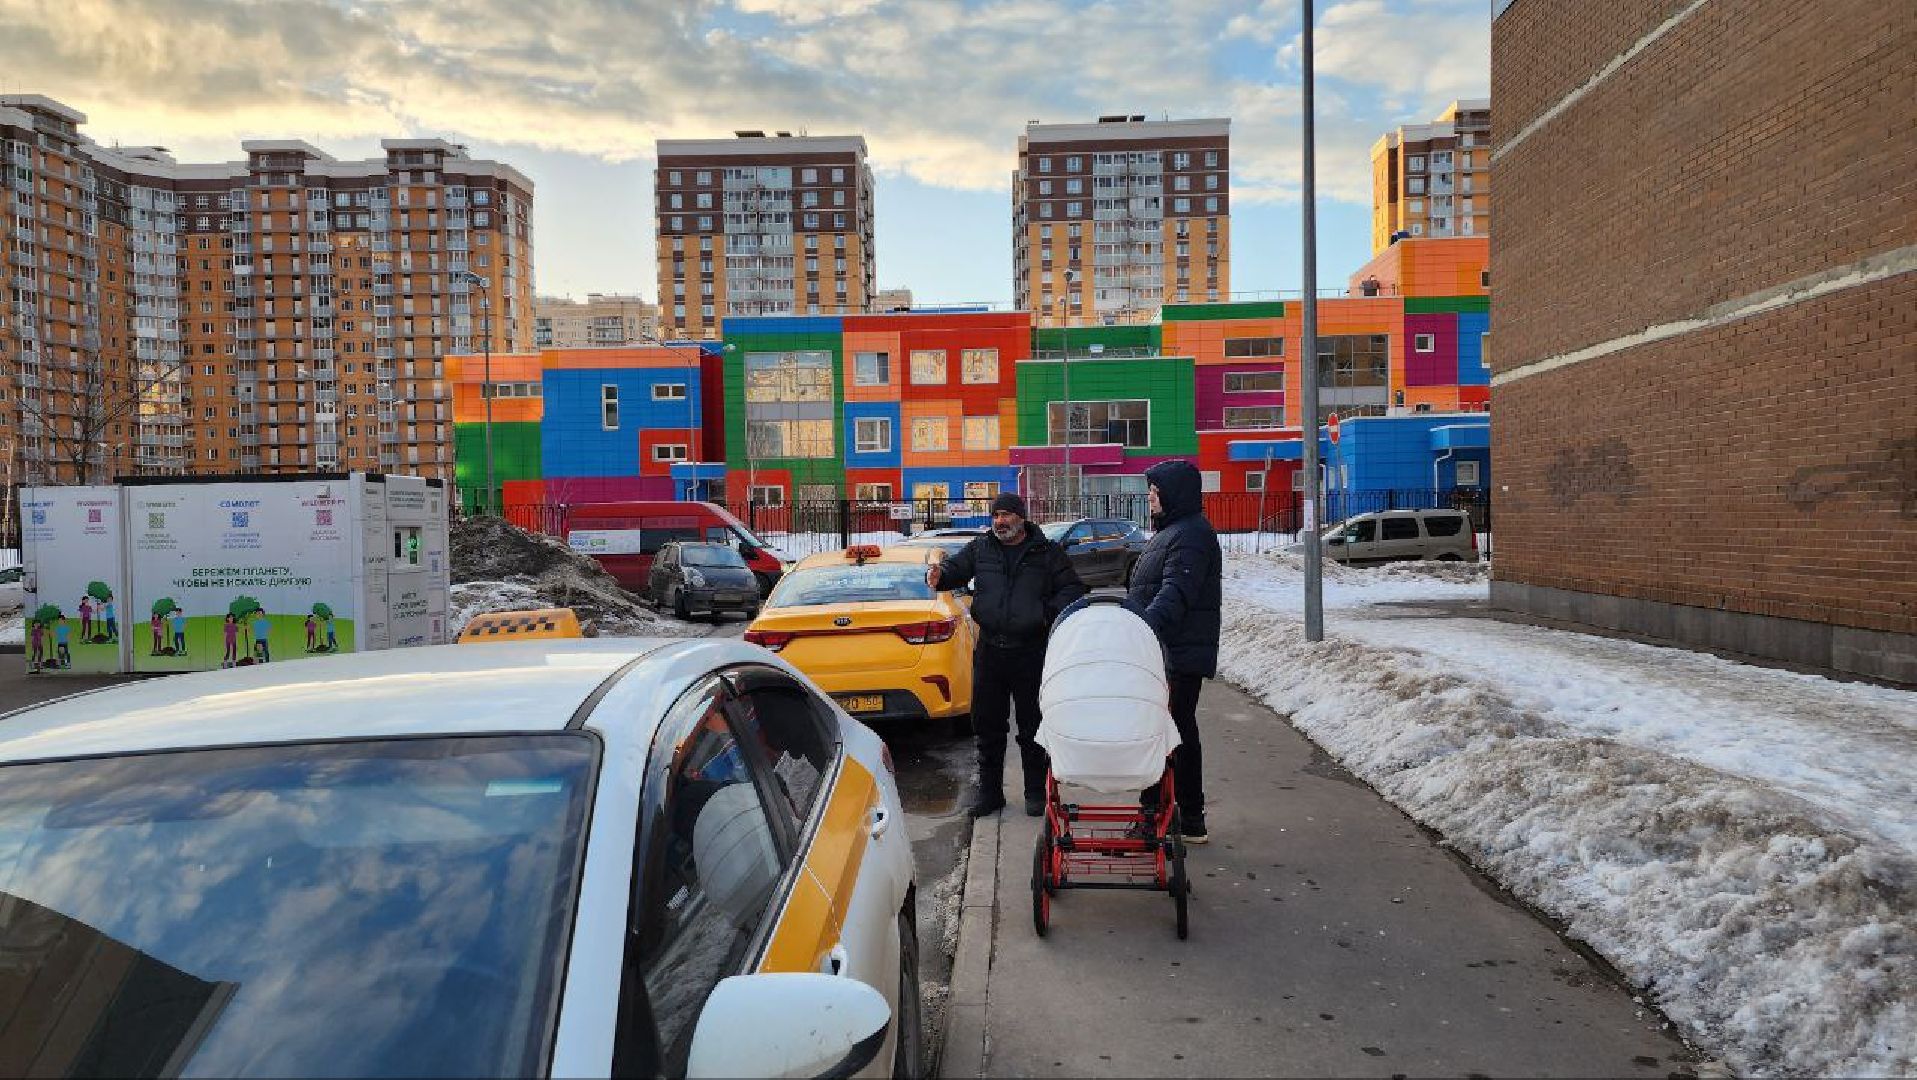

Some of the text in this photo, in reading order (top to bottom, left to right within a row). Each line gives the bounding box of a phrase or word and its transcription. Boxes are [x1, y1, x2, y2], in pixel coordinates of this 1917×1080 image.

[173, 577, 312, 588] ЧТОБЫ НЕ ИСКАТЬ ДРУГУЮ
